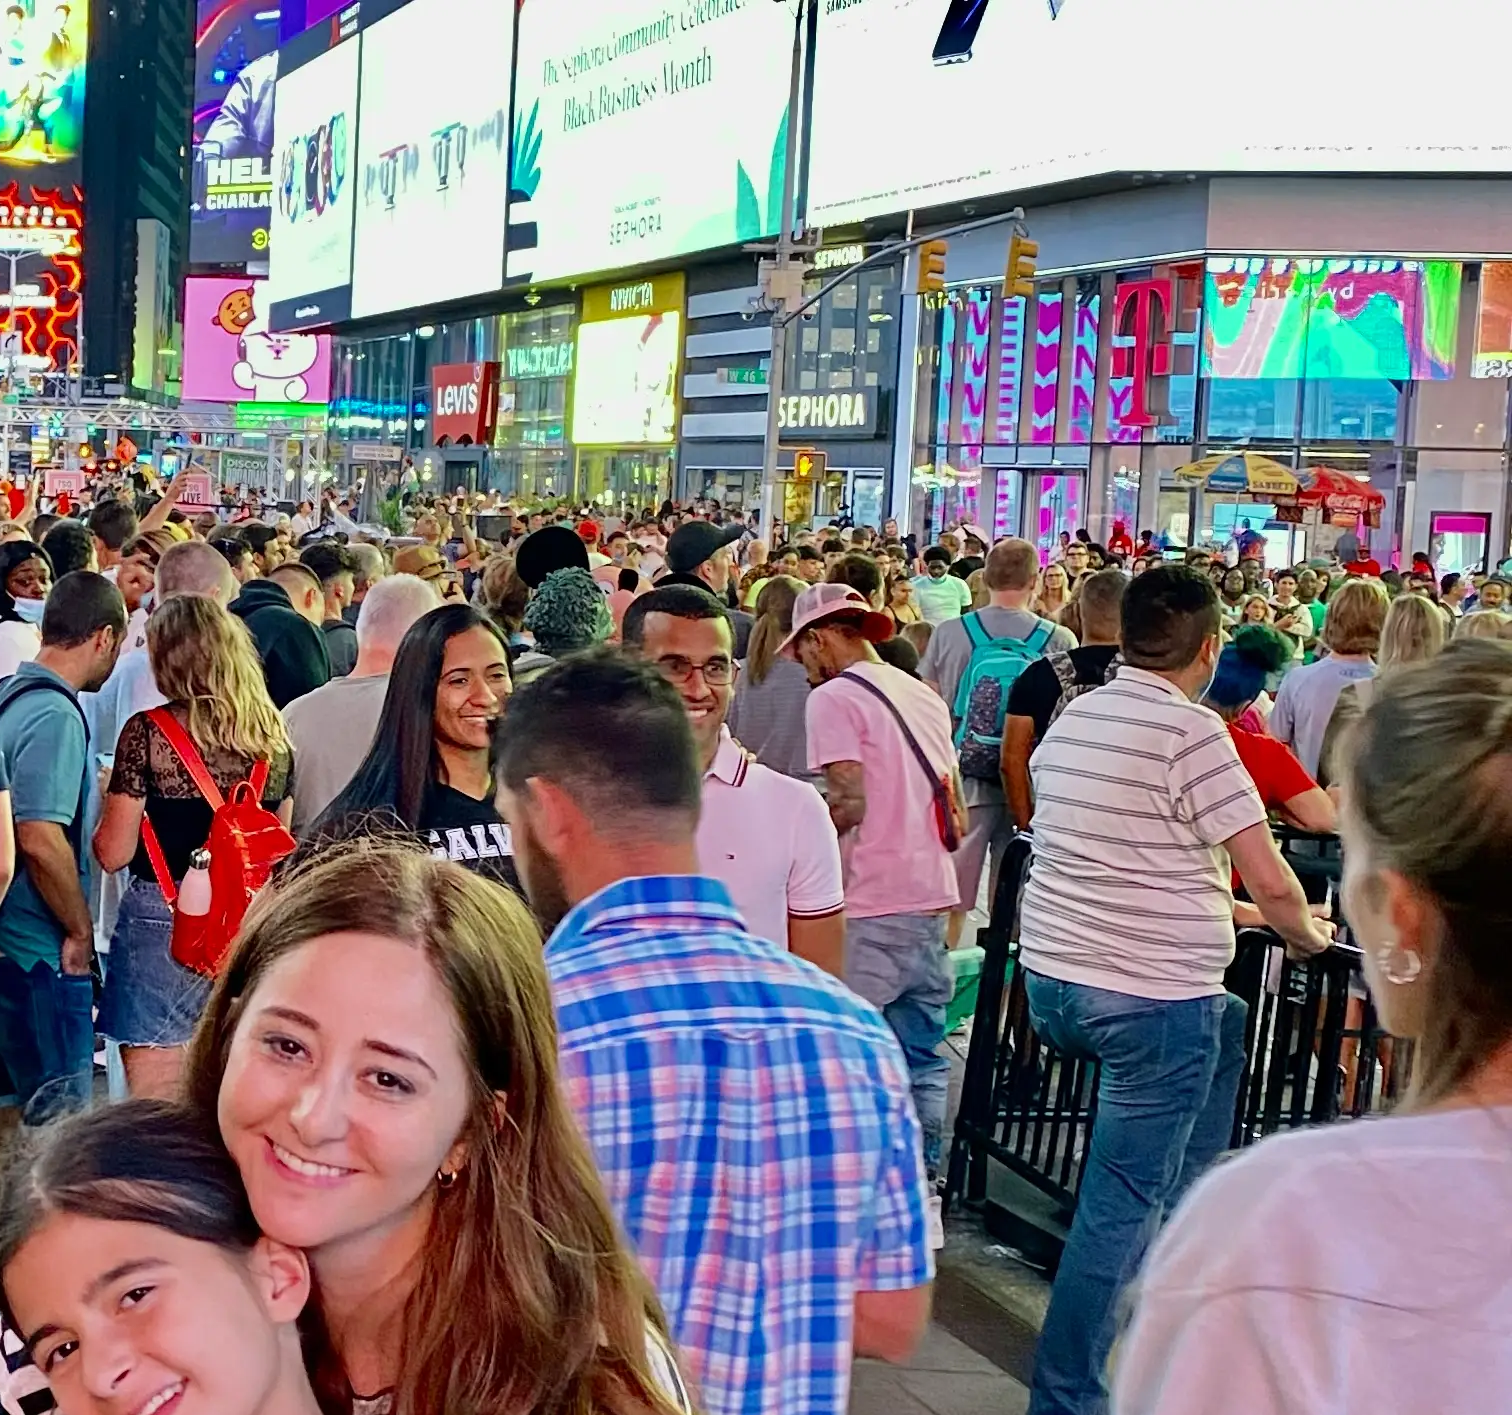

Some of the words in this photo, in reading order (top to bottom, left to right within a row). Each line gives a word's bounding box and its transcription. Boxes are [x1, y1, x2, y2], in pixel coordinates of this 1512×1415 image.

[563, 90, 596, 131] Black
[598, 77, 658, 120] Business
[662, 46, 713, 95] Month
[206, 192, 272, 211] CHARLA
[609, 213, 662, 246] SEPHORA
[814, 245, 864, 270] SEPHORA
[743, 370, 755, 383] 46
[777, 393, 866, 428] SEPHORA
[181, 492, 201, 503] LIVE
